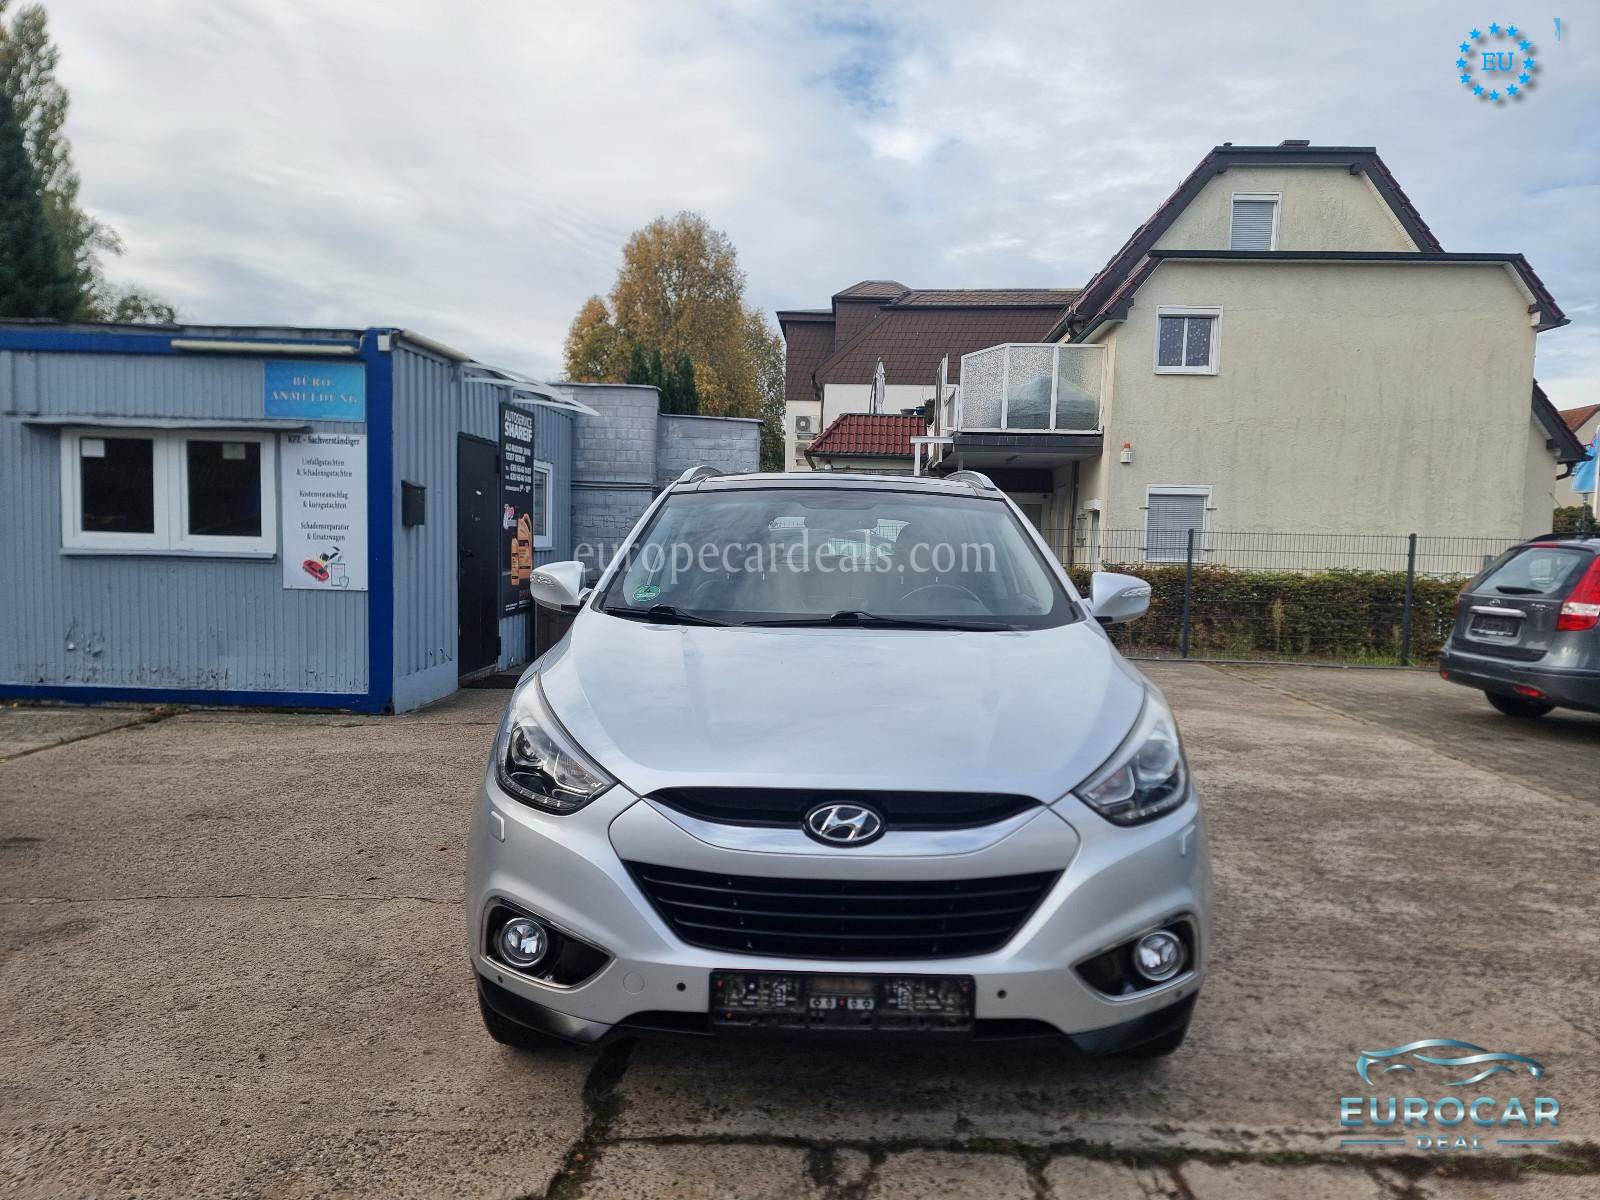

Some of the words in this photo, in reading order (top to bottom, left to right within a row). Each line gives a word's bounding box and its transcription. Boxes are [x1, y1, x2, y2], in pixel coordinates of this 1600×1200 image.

[505, 421, 532, 442] SHAREIF
[308, 435, 360, 447] Sachverständiger
[302, 456, 345, 467] Unfallgutachten
[313, 533, 346, 542] Ersatzwagen
